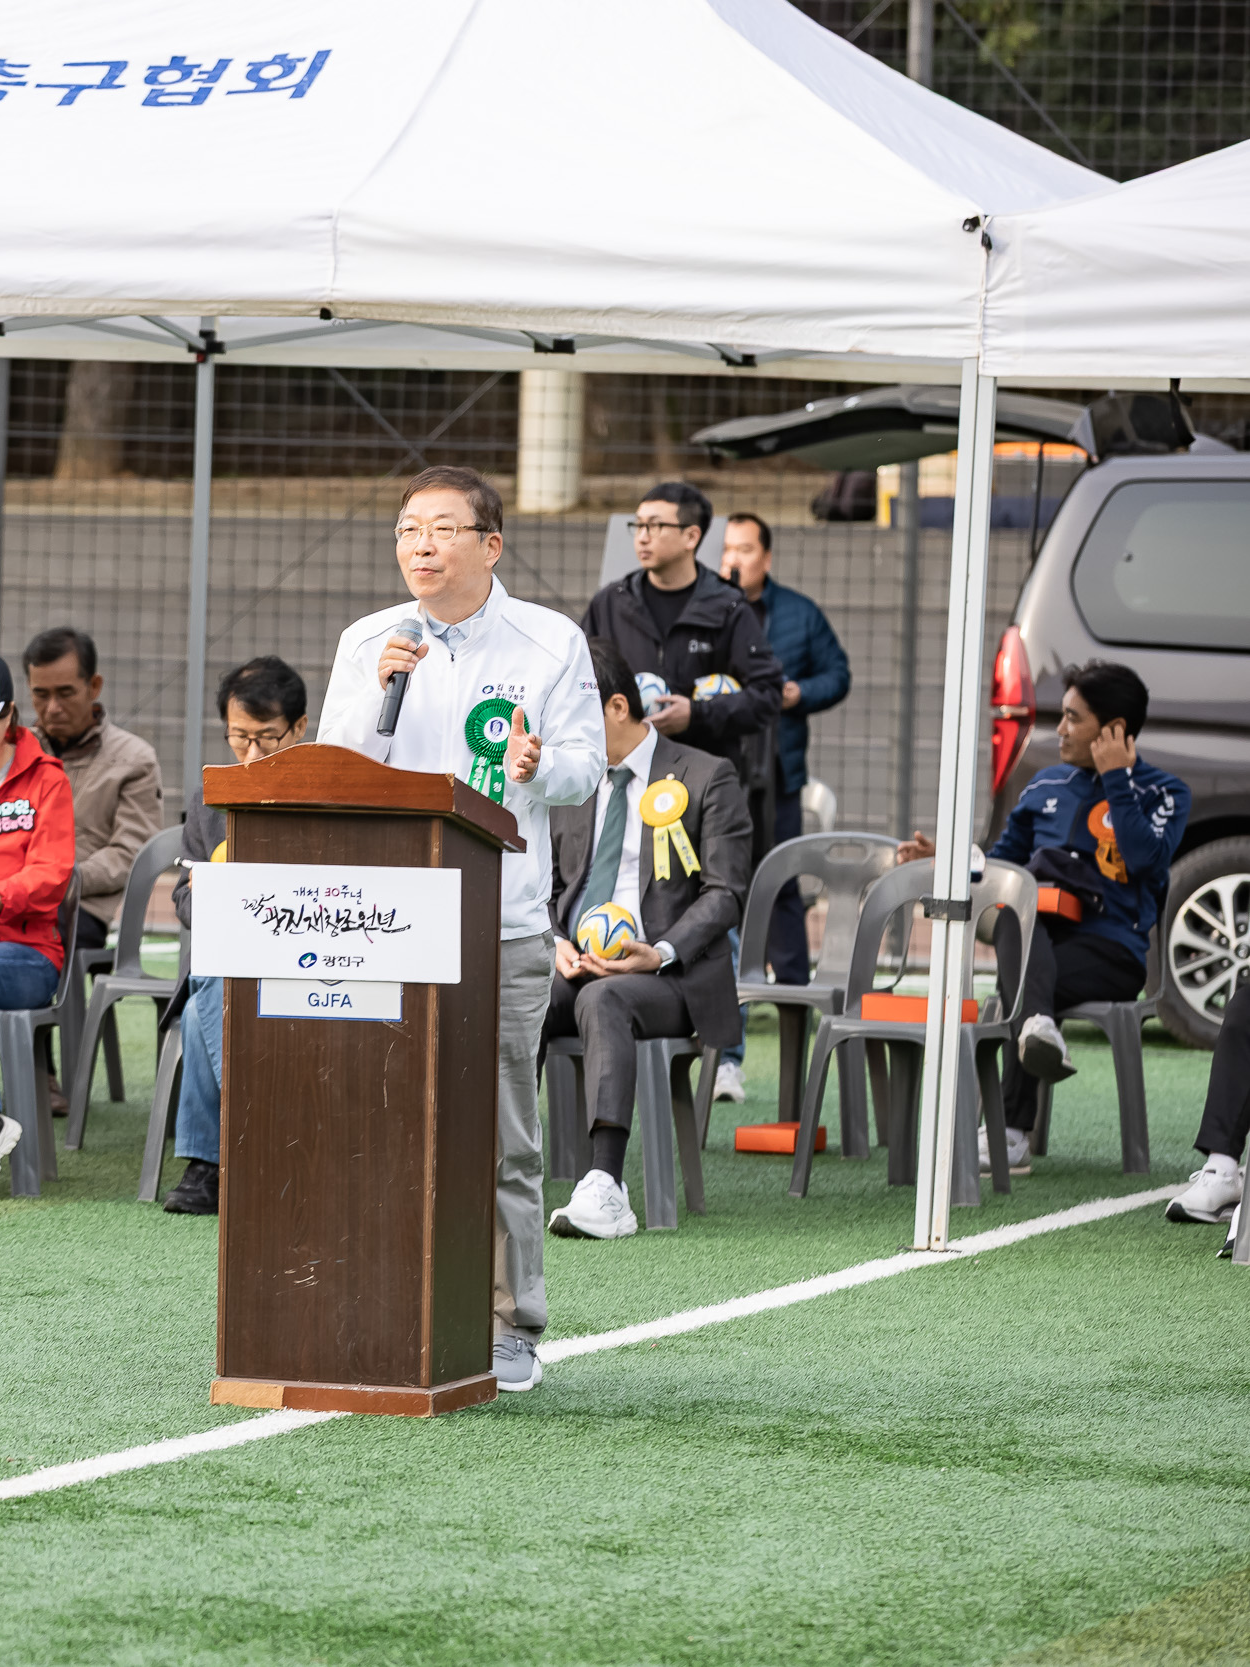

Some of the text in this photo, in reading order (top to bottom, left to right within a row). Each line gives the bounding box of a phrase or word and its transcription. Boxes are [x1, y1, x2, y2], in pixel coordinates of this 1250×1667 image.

[293, 884, 362, 905] 개청 30주년
[322, 956, 364, 967] 광진구
[308, 993, 352, 1008] GJFA
